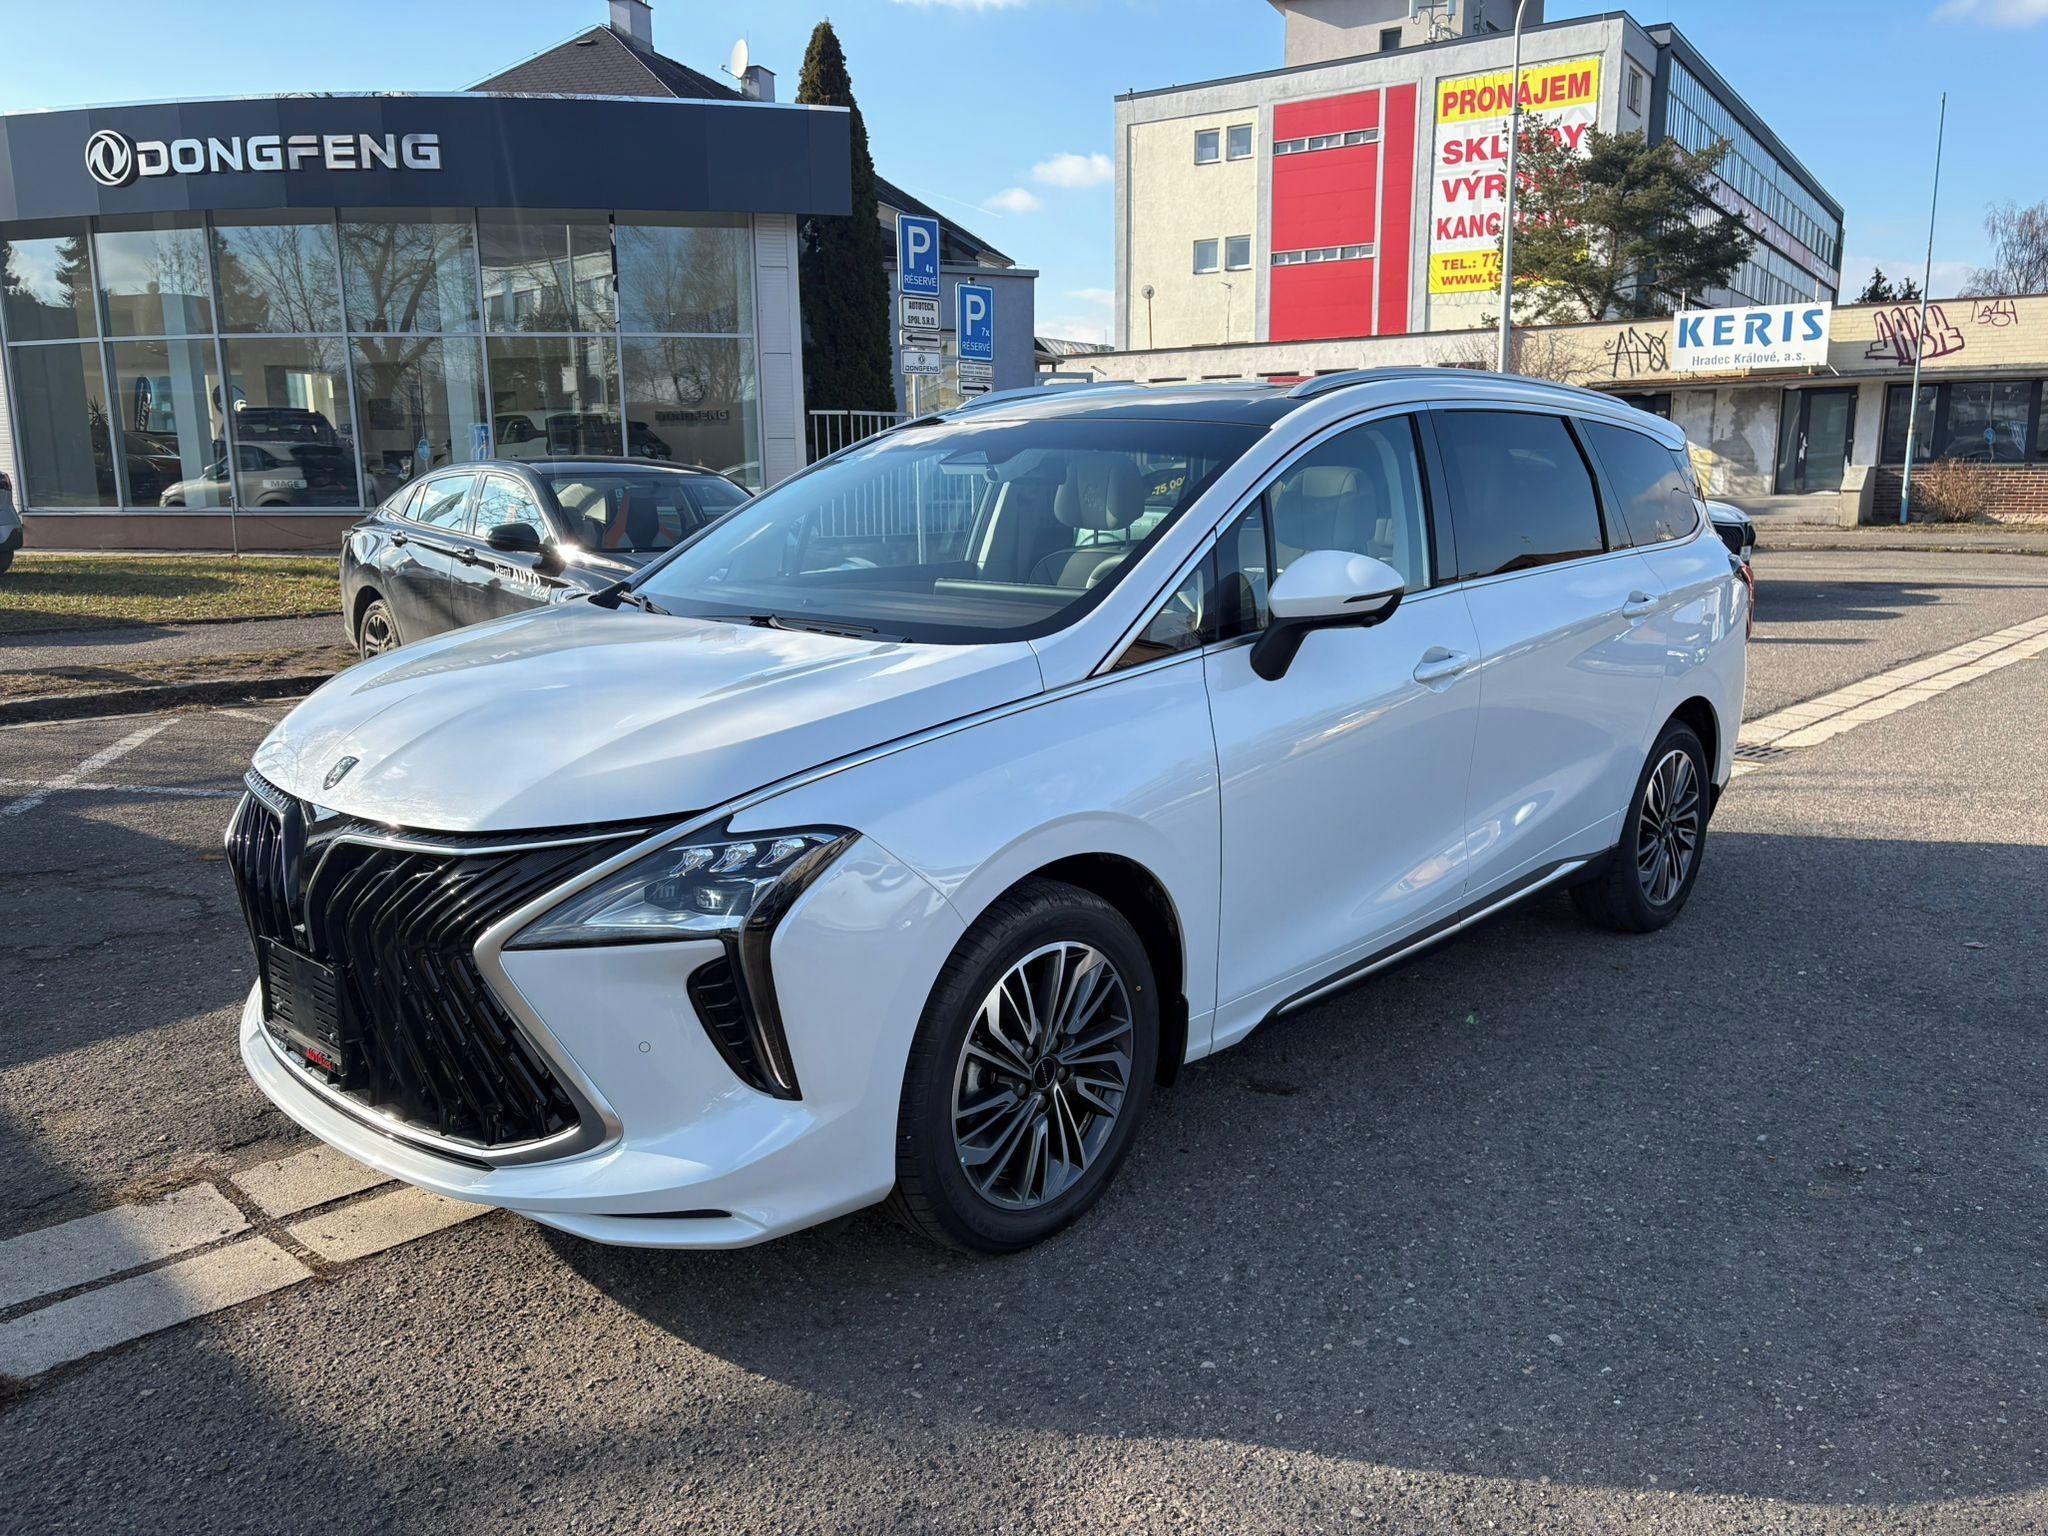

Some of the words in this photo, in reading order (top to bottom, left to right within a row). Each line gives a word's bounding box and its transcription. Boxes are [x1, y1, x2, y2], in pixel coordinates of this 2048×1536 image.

[1442, 71, 1591, 117] PRONÁJEM
[136, 133, 442, 176] DONGFENG
[908, 225, 931, 269] P
[925, 263, 933, 273] 4x
[1442, 259, 1476, 270] TEL.:
[904, 273, 937, 287] RÉSERVÉ
[966, 293, 986, 336] P
[981, 327, 990, 337] 7x
[1678, 309, 1824, 348] KERIS
[962, 339, 991, 352] RÉSERVÉ
[1692, 355, 1730, 366] Hradec
[1734, 351, 1780, 364] Králové,
[1784, 352, 1806, 362] a.s.
[270, 480, 300, 488] MAGE
[494, 563, 511, 578] Rent
[512, 568, 541, 587] AUTO
